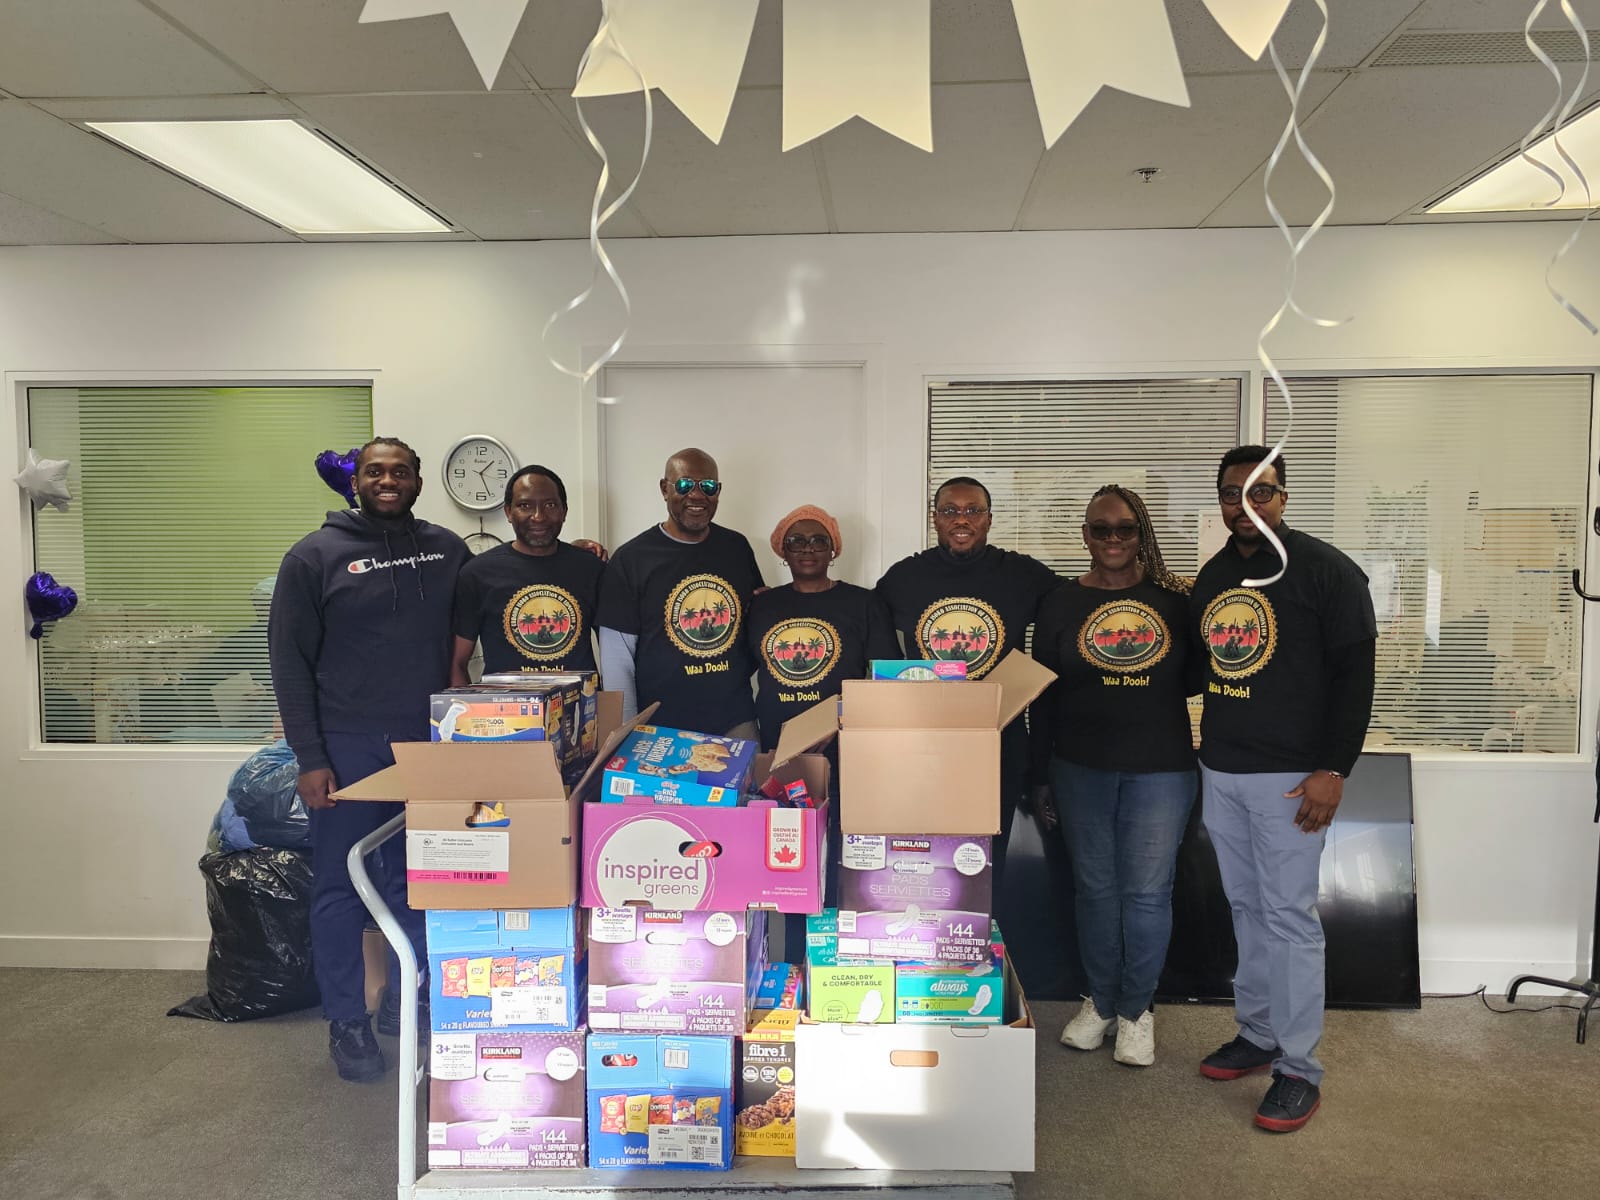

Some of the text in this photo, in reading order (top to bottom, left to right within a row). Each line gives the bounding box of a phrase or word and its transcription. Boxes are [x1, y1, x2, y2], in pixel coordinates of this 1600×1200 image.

[476, 446, 488, 456] 12
[454, 468, 465, 479] 9
[496, 469, 508, 479] 3
[475, 491, 487, 501] 6
[347, 552, 444, 574] Champion
[684, 660, 729, 675] Waa Dooh!
[1102, 675, 1150, 687] Waa Dooh!
[1223, 684, 1250, 698] Dooh!
[778, 691, 820, 703] Waa Dooh!
[847, 834, 862, 844] 3+
[892, 840, 930, 848] KIRKLAND
[604, 857, 700, 886] inspired
[891, 875, 929, 886] PADS
[643, 883, 699, 898] greens
[870, 884, 952, 898] SERVIETTES
[596, 907, 612, 919] 3+
[644, 911, 683, 919] KIRKLAND
[946, 923, 975, 938] 144
[935, 936, 951, 944] PADS
[967, 953, 974, 961] DE
[929, 978, 969, 996] always
[697, 994, 725, 1008] 144
[466, 1009, 491, 1019] Varie
[686, 1008, 701, 1016] PADS
[435, 1044, 451, 1054] 3+
[482, 1047, 521, 1055] KIRKLAND
[748, 1043, 786, 1057] fibre 1
[539, 1129, 567, 1143] 144
[538, 1152, 558, 1160] PACKS
[558, 1152, 565, 1160] OF
[624, 1146, 649, 1155] Varie
[535, 1159, 560, 1167] PAQUETS
